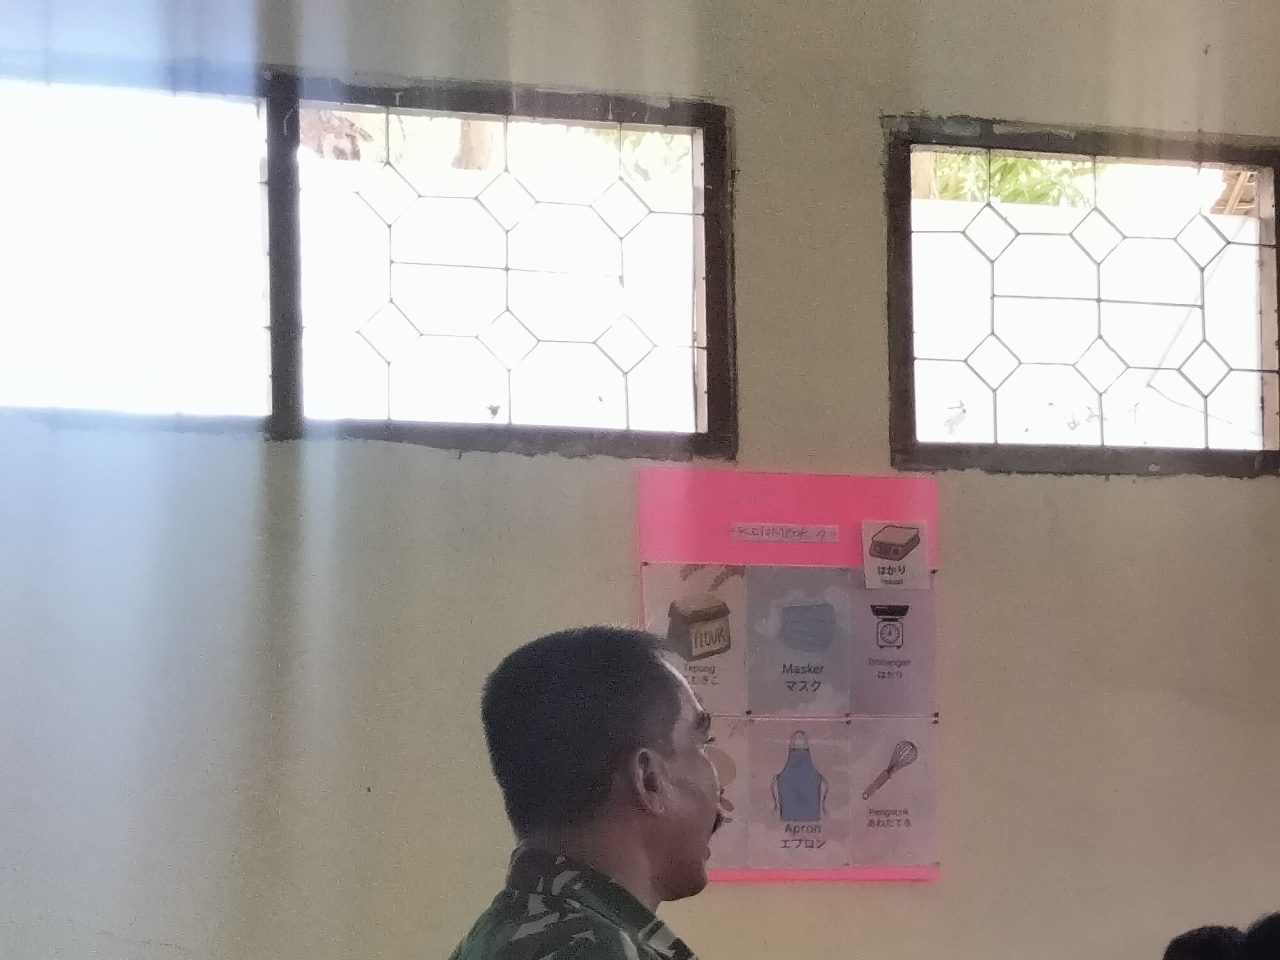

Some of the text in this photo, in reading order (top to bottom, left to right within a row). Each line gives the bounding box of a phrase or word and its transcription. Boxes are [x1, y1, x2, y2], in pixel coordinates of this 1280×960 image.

[878, 565, 906, 576] はかり
[694, 627, 725, 649] FLOUR
[782, 663, 824, 675] Masker
[785, 680, 822, 692] マスク
[784, 823, 822, 835] Apron
[780, 839, 827, 849] エプロン
